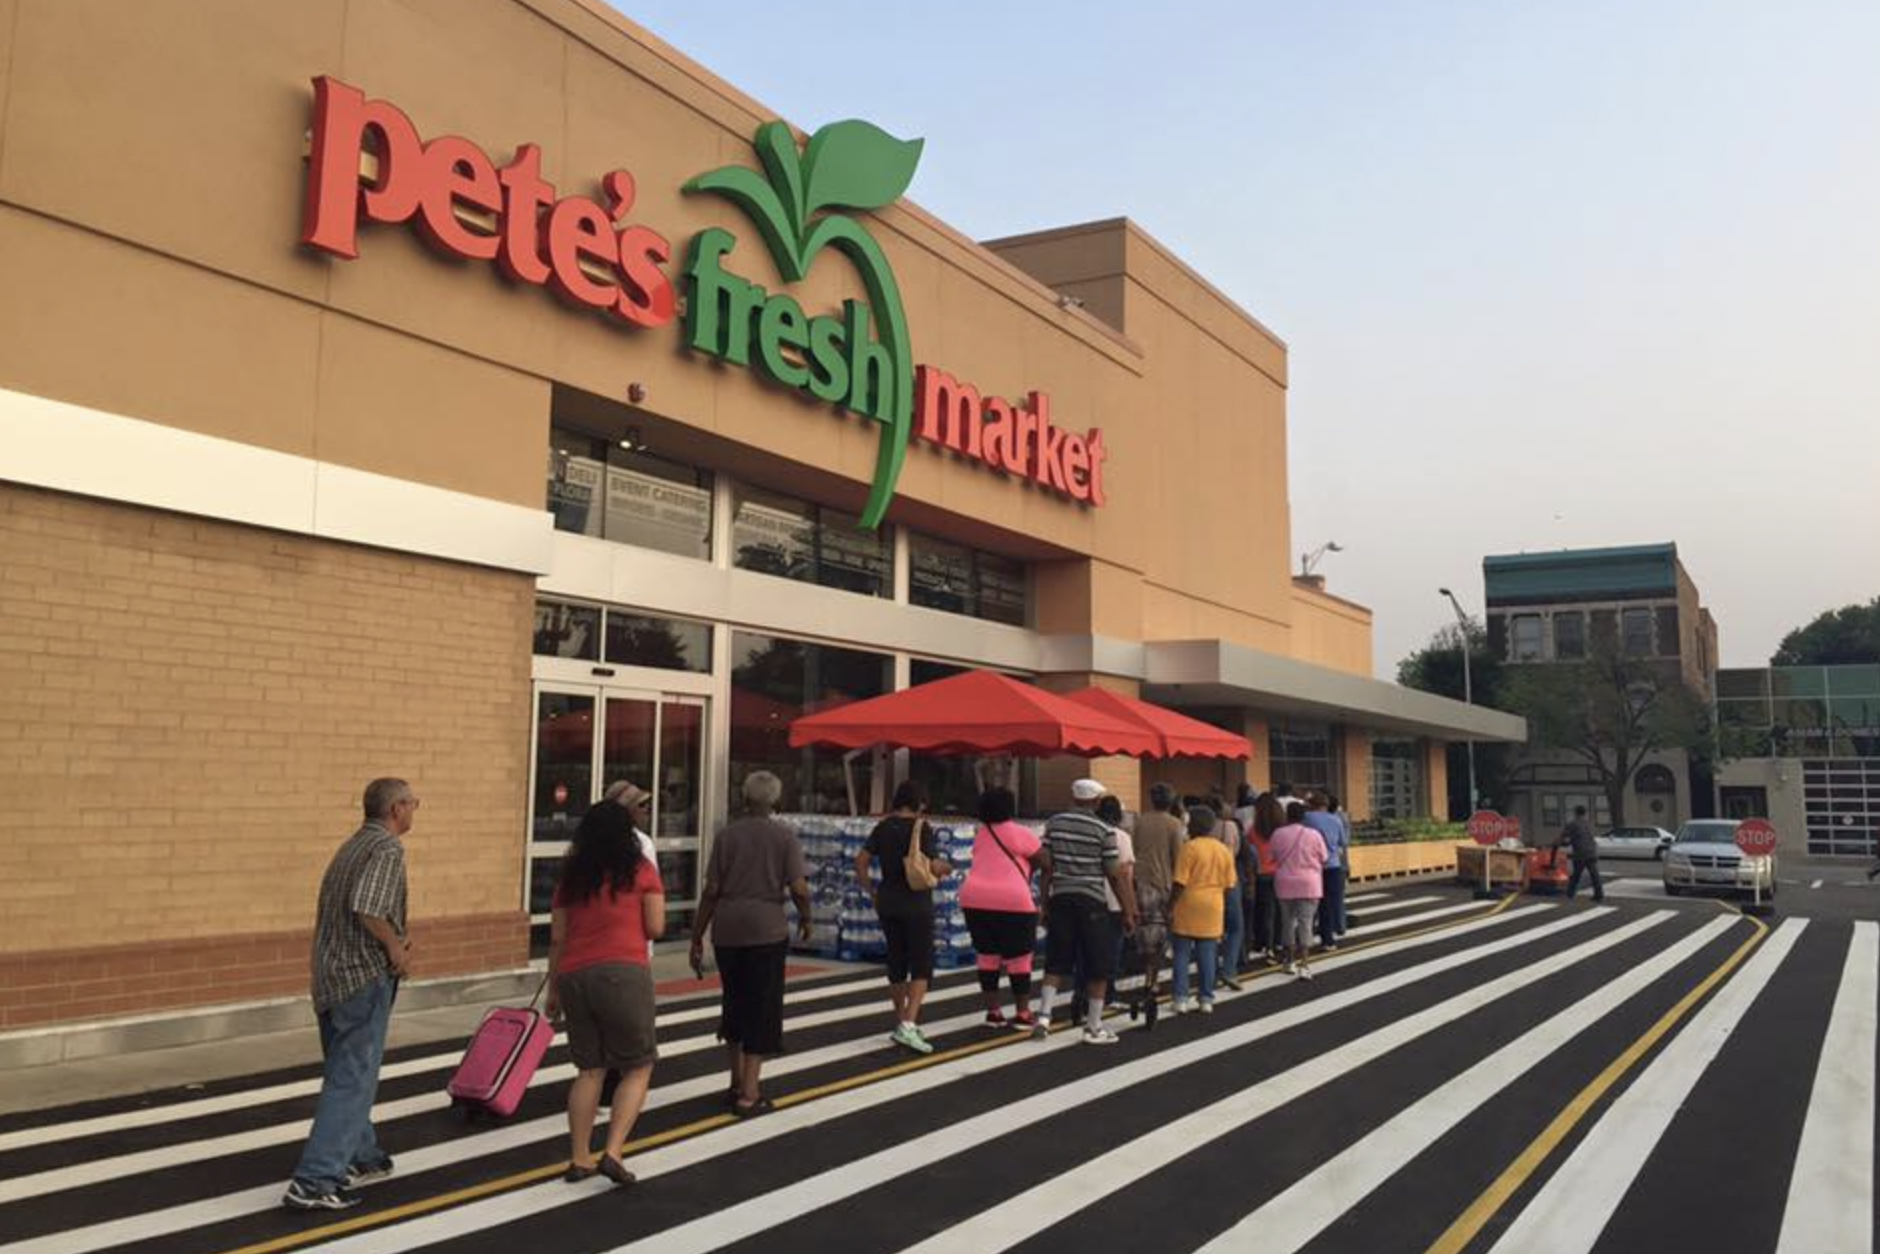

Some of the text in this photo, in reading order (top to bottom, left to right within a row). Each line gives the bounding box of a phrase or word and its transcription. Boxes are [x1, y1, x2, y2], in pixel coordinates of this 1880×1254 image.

[303, 75, 676, 328] pete's
[685, 227, 896, 425] fresh
[914, 364, 1107, 507] market
[1469, 821, 1502, 836] STOP
[1738, 829, 1775, 845] STOP
